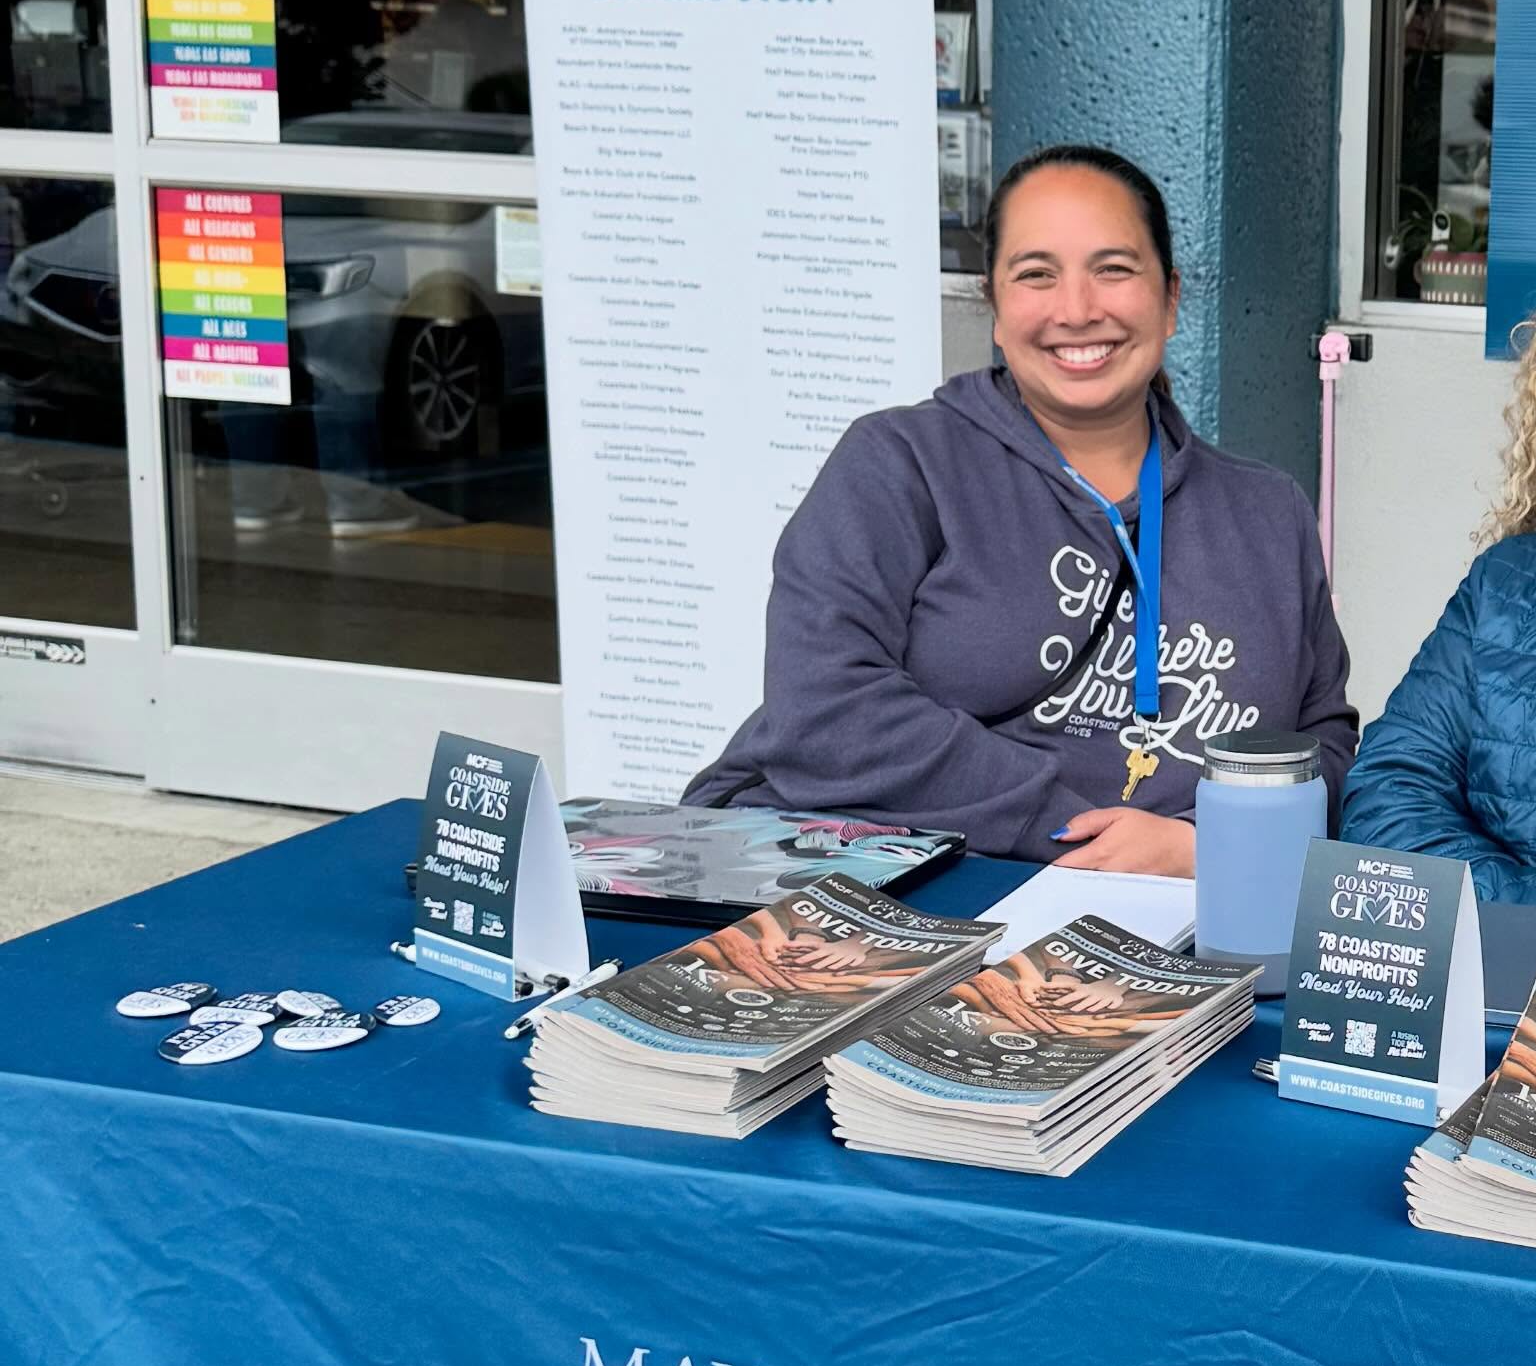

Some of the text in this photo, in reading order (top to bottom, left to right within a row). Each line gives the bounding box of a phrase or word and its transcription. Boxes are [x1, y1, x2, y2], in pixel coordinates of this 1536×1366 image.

[1063, 724, 1093, 739] GIVES
[1067, 714, 1121, 732] COASTSIDE
[466, 753, 489, 769] MCF
[450, 766, 512, 796] COASTSIDE
[436, 818, 506, 854] 78 COASTSIDE
[437, 838, 501, 872] NONPROFITS
[1357, 859, 1391, 876] MCF
[424, 855, 510, 895] Need Your Help!
[1334, 874, 1430, 904] COASTSIDE
[791, 900, 861, 939] GIVE
[859, 931, 957, 954] TODAY
[1074, 919, 1102, 936] MCF
[1318, 931, 1427, 968] 78 COASTSIDE
[1044, 940, 1115, 981] GIVE
[1114, 972, 1214, 997] TODAY
[1320, 954, 1419, 988] NONPROFITS
[1298, 971, 1434, 1013] Need Your Help!
